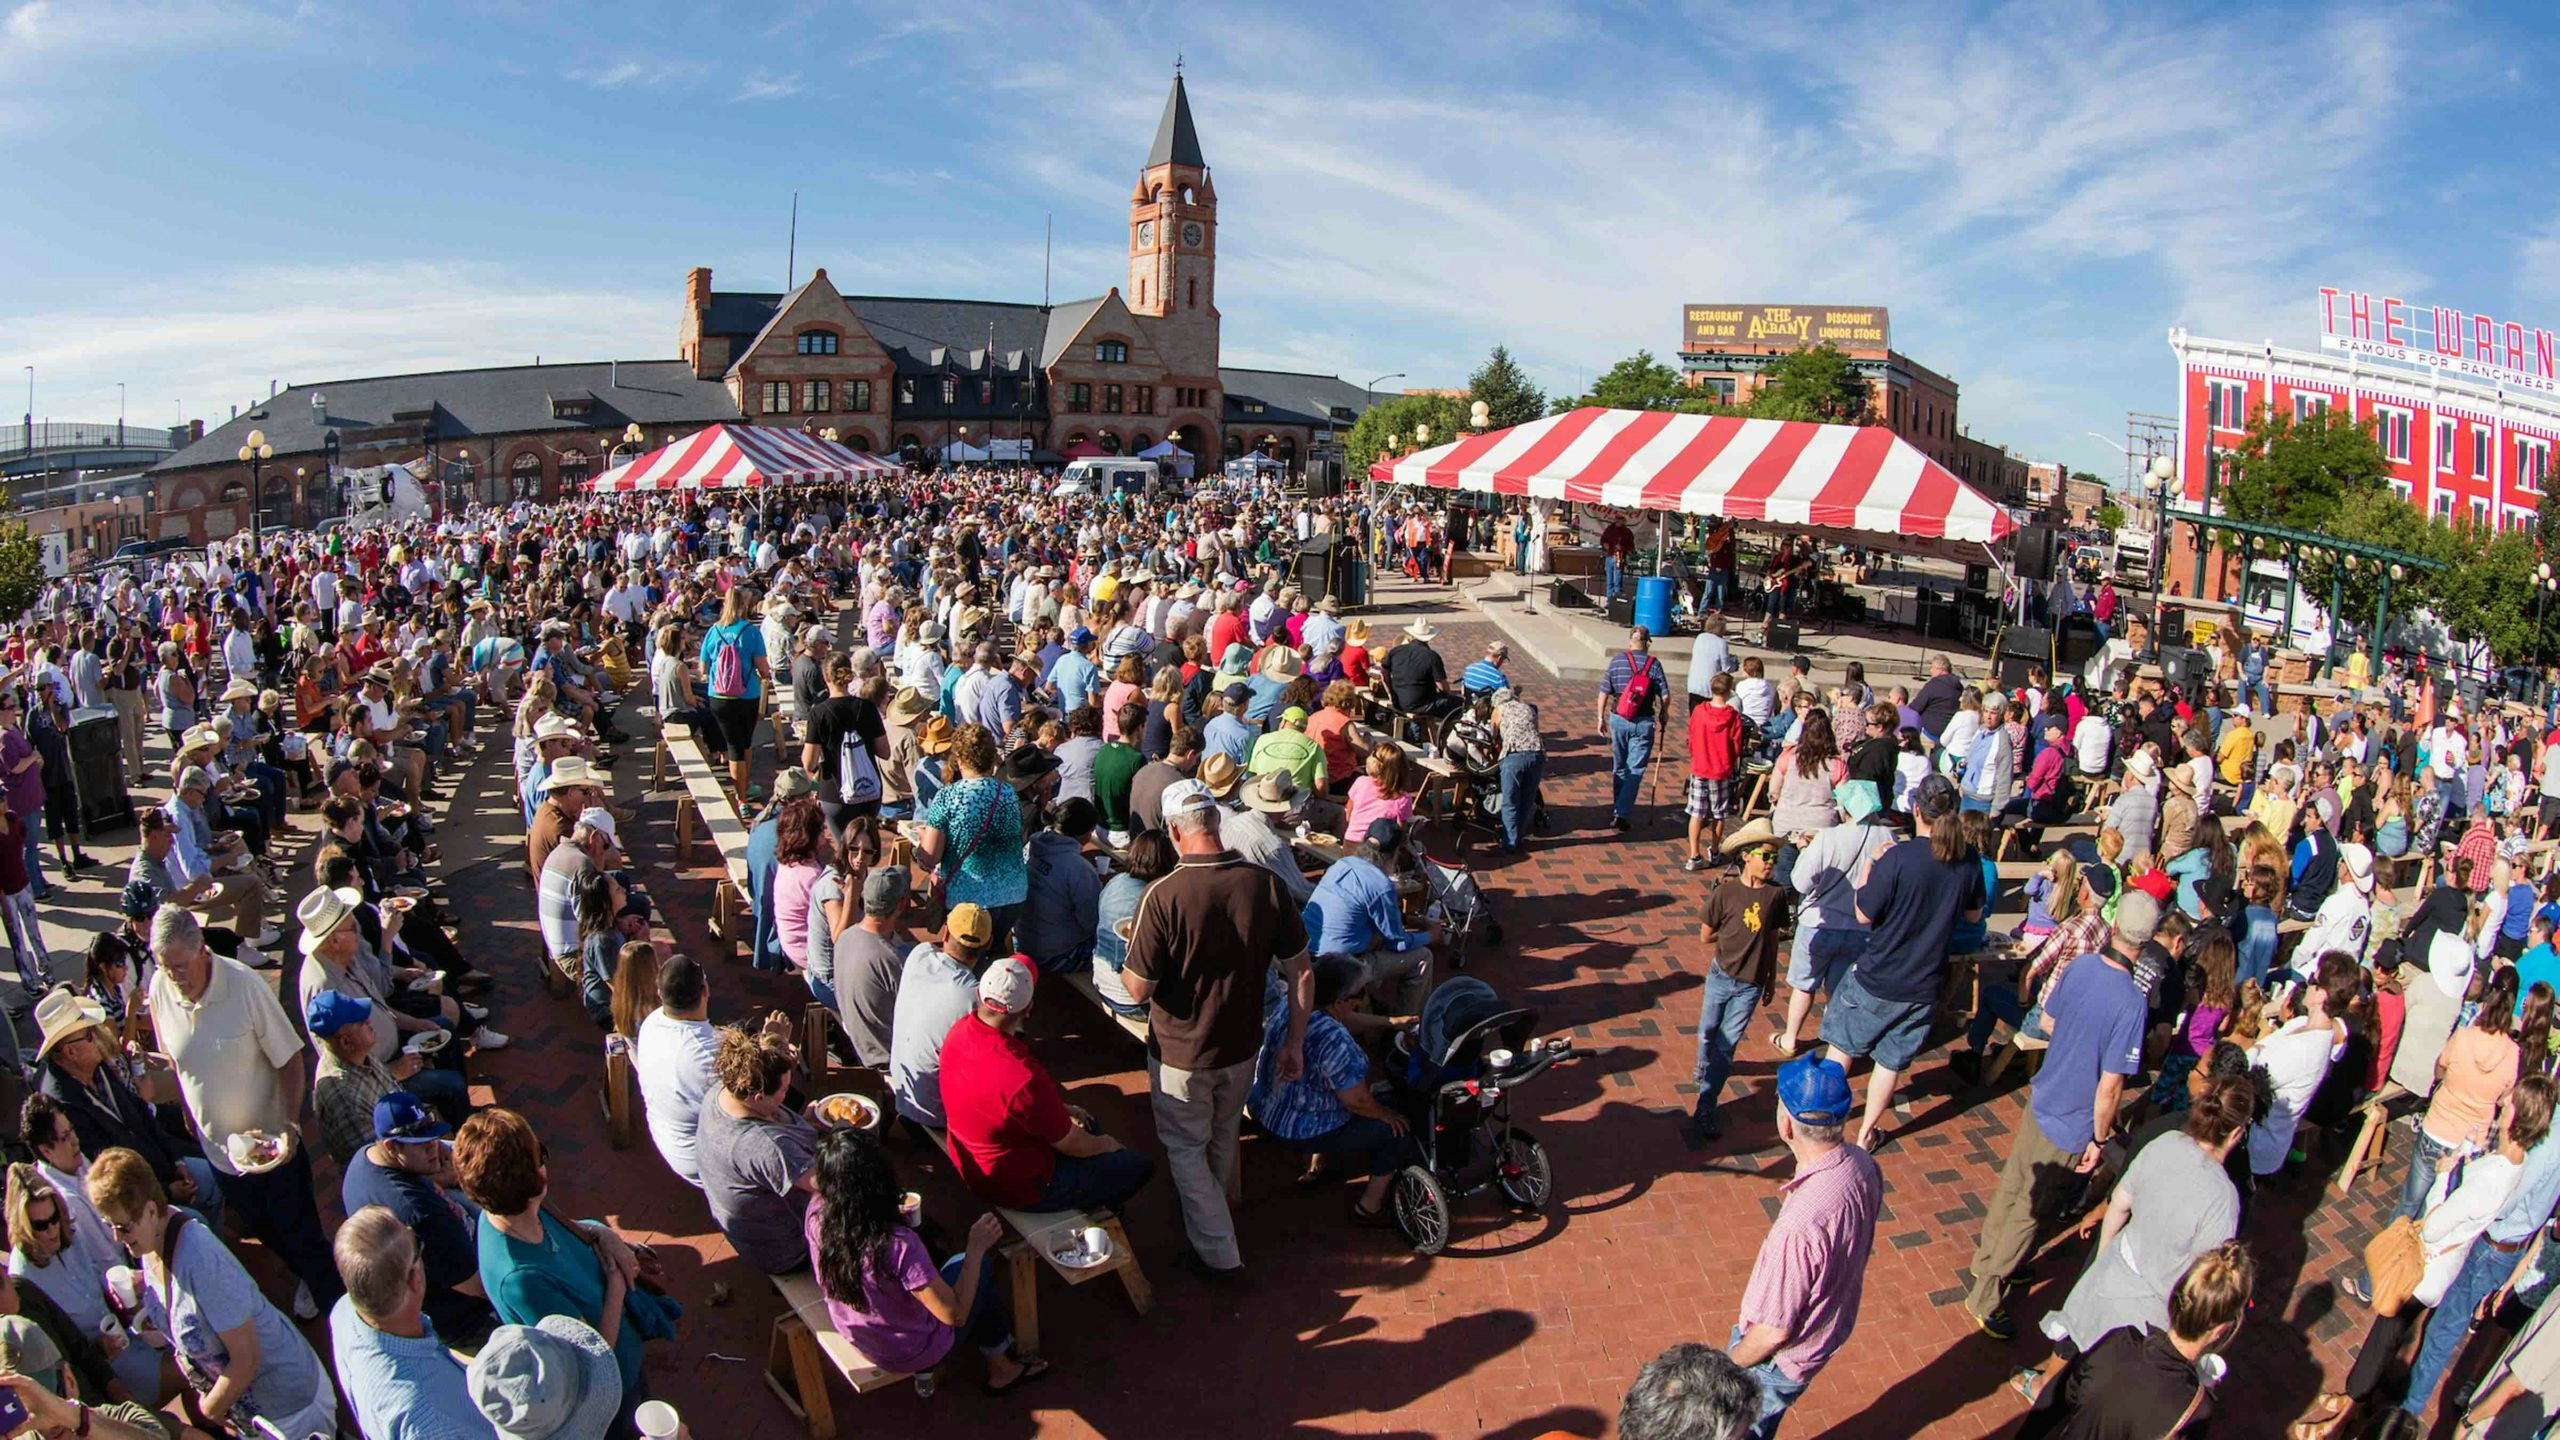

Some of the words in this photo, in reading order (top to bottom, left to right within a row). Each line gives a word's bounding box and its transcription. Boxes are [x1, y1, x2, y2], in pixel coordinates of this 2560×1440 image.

[1690, 311, 1743, 322] RESTAURANT
[1764, 308, 1791, 322] THE
[1826, 312, 1872, 325] DISCOUNT
[1697, 324, 1715, 336] AND
[1717, 325, 1735, 336] BAR
[1819, 327, 1851, 339] LIQUOR
[1853, 328, 1881, 340] STORE
[2320, 287, 2405, 347] THE
[2433, 306, 2555, 380] WRAN
[2339, 339, 2407, 361] FAMOUS
[2418, 353, 2449, 368] FOR
[2460, 361, 2554, 392] RANCHWEAR
